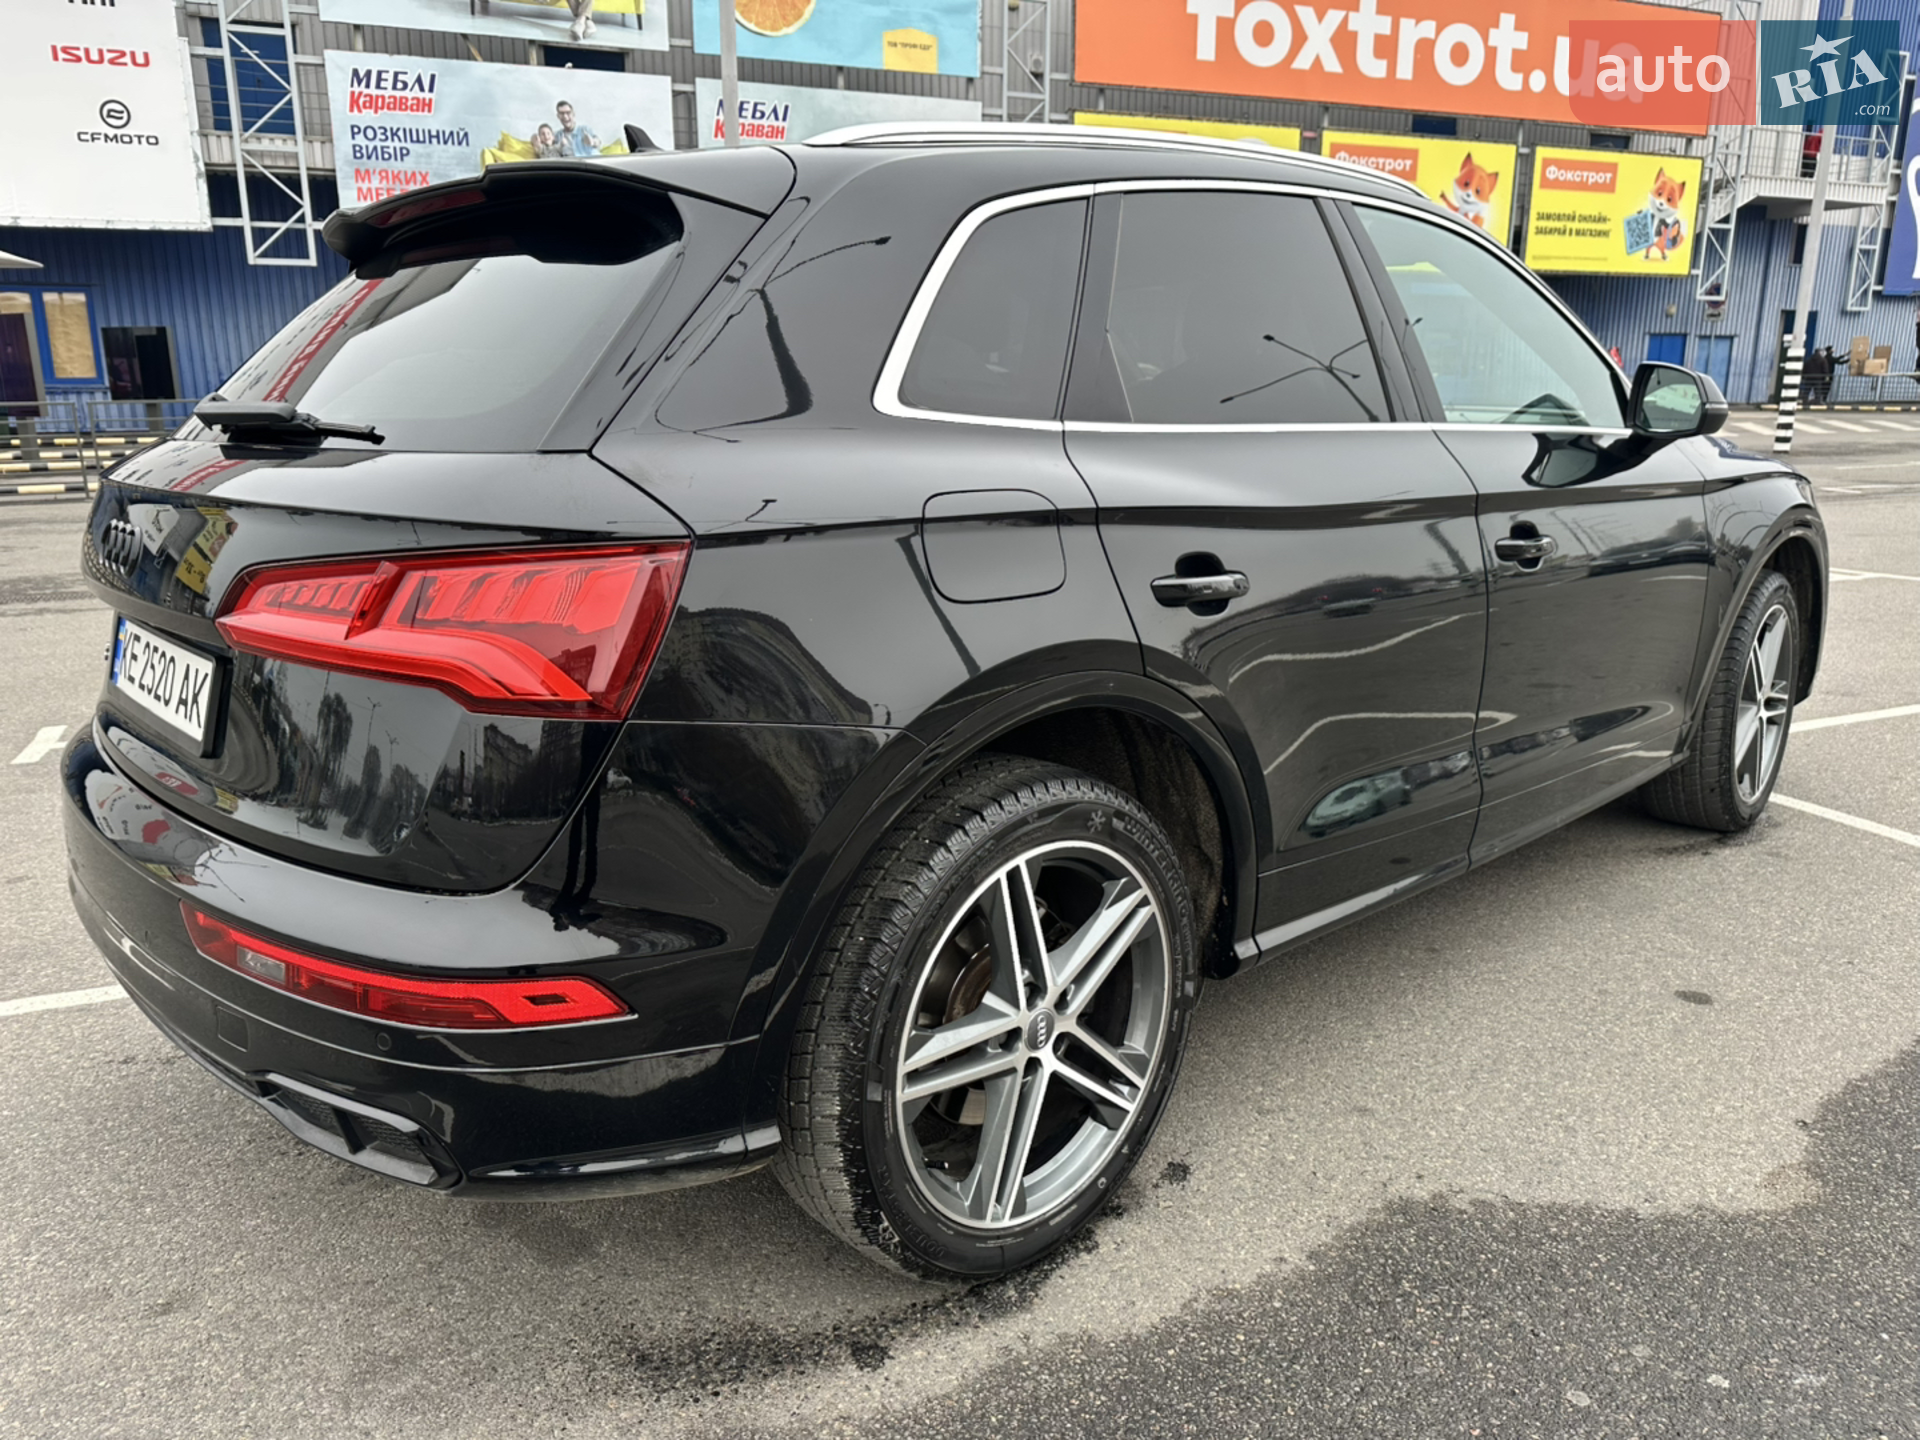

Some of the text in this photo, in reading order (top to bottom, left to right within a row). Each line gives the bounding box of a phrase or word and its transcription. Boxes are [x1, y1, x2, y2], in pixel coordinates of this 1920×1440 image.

[50, 44, 151, 68] ISUZU
[350, 67, 437, 93] МЕБЛІ
[348, 90, 433, 114] Караван
[76, 131, 159, 146] CFMOTO
[350, 124, 470, 147] РОЗКІШНИЙ
[351, 143, 411, 162] ВИБІР
[1335, 150, 1413, 172] Фокстрот
[1545, 164, 1613, 186] Фокстрот
[1535, 210, 1577, 222] ЗАМОВЛЯЙ
[1534, 224, 1567, 236] ЗАБИРАЙ
[1568, 227, 1574, 237] В
[119, 627, 209, 729] KE 2520 AK
